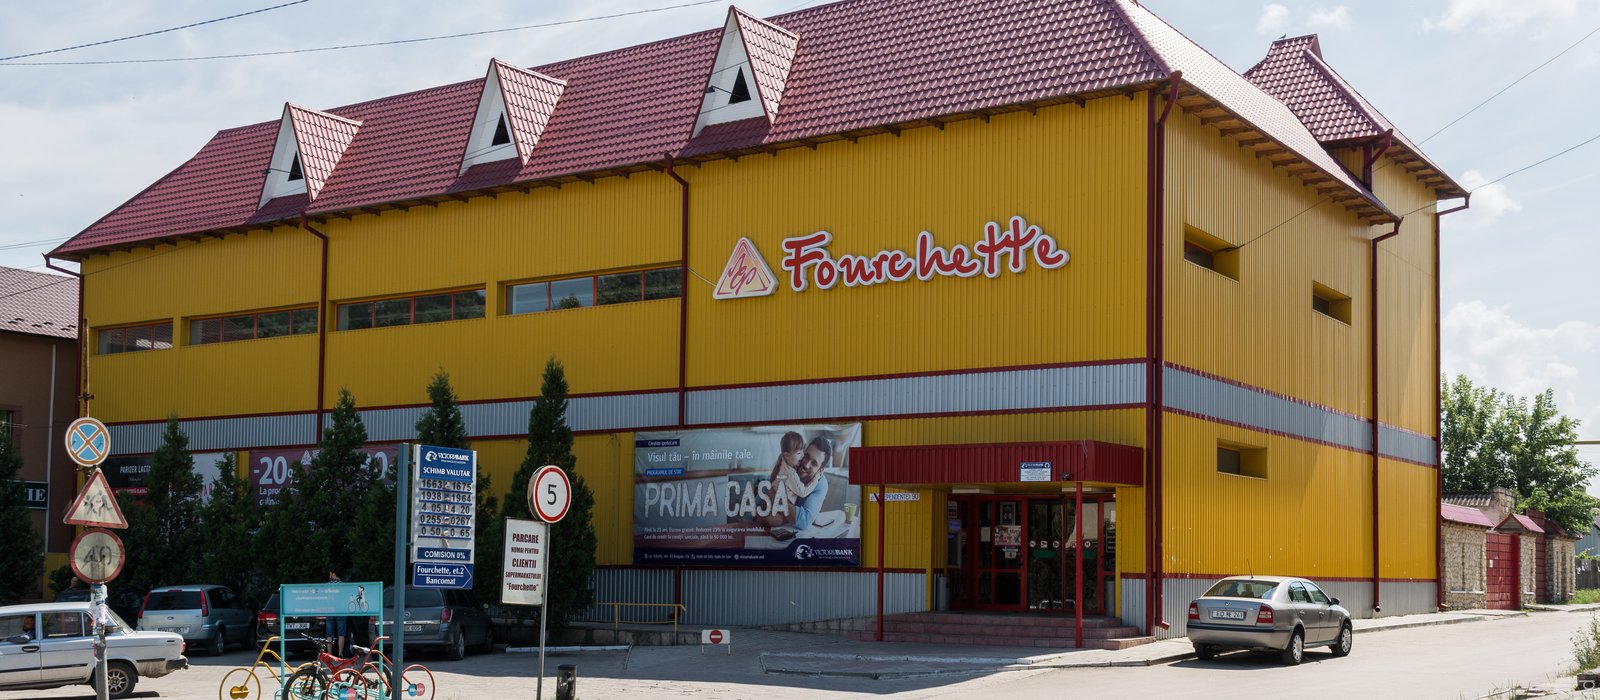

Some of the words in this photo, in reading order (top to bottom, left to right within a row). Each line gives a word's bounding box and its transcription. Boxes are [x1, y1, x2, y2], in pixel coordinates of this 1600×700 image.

[782, 216, 1069, 292] Fourchette
[647, 452, 666, 462] Visul
[668, 451, 682, 462] tău
[692, 450, 700, 460] în
[702, 449, 732, 460] mâinile
[735, 448, 754, 460] tale.
[423, 466, 446, 474] SCHIMB
[422, 480, 442, 488] 1663
[452, 482, 471, 491] 1675
[422, 491, 442, 500] 1938
[452, 494, 471, 502] 1964
[547, 484, 557, 505] 5
[644, 482, 718, 518] PRIMA
[724, 480, 790, 518] CASA
[512, 533, 539, 544] PARCARE
[424, 550, 455, 558] COMISION
[512, 558, 536, 568] CLIENTII
[417, 566, 451, 575] Fourchette,
